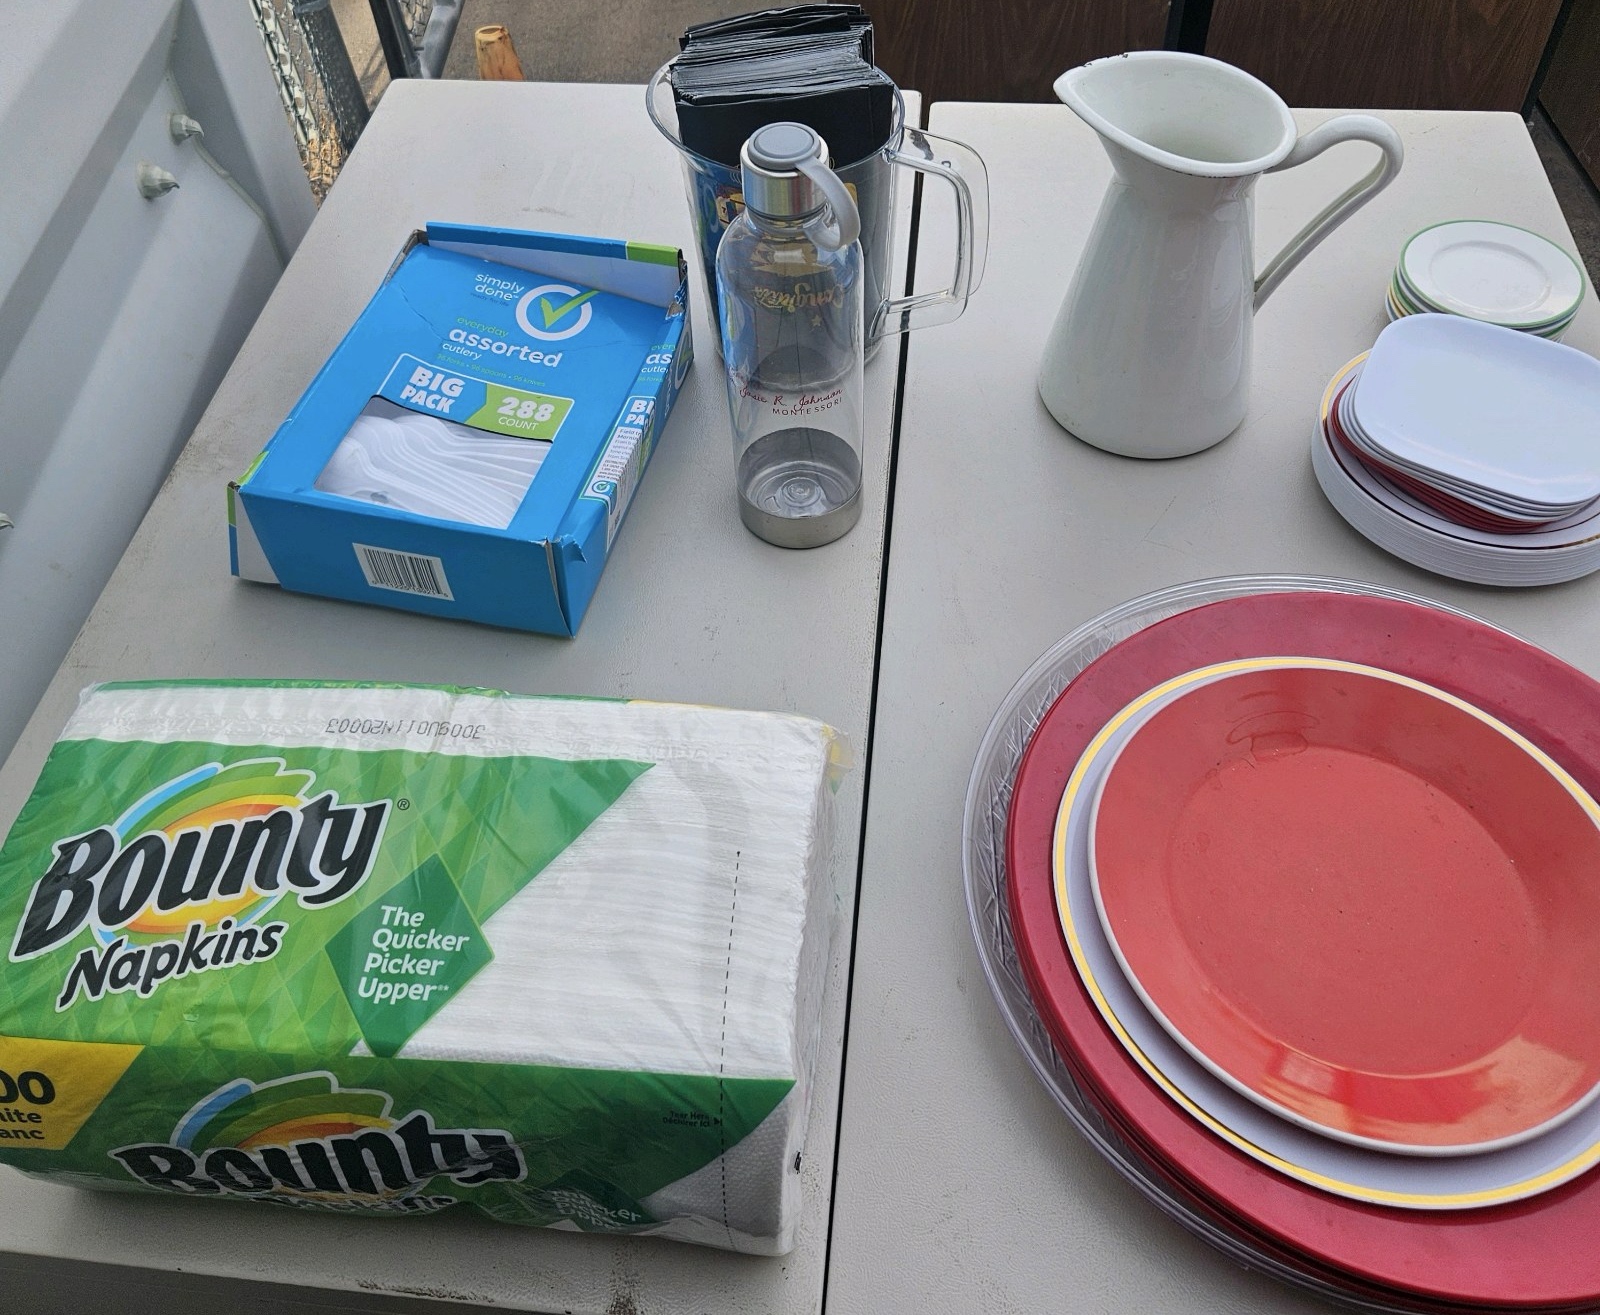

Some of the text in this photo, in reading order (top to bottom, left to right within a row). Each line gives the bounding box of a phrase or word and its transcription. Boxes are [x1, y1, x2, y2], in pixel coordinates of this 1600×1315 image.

[475, 273, 525, 294] simply
[475, 284, 513, 301] done
[457, 317, 509, 338] everyday
[442, 343, 482, 361] cutlery
[449, 328, 563, 368] assorted
[409, 365, 466, 398] BIG
[400, 384, 456, 413] PACK
[496, 396, 555, 423] 288
[772, 396, 842, 416] MONTESSORI
[793, 389, 843, 412] Johnson
[498, 416, 539, 431] COUNT
[12, 792, 391, 959] Bounty
[381, 905, 425, 927] The
[372, 928, 470, 952] Quicker
[57, 921, 285, 1009] Napkins
[364, 952, 445, 976] Picker
[112, 1113, 525, 1193] Bounty
